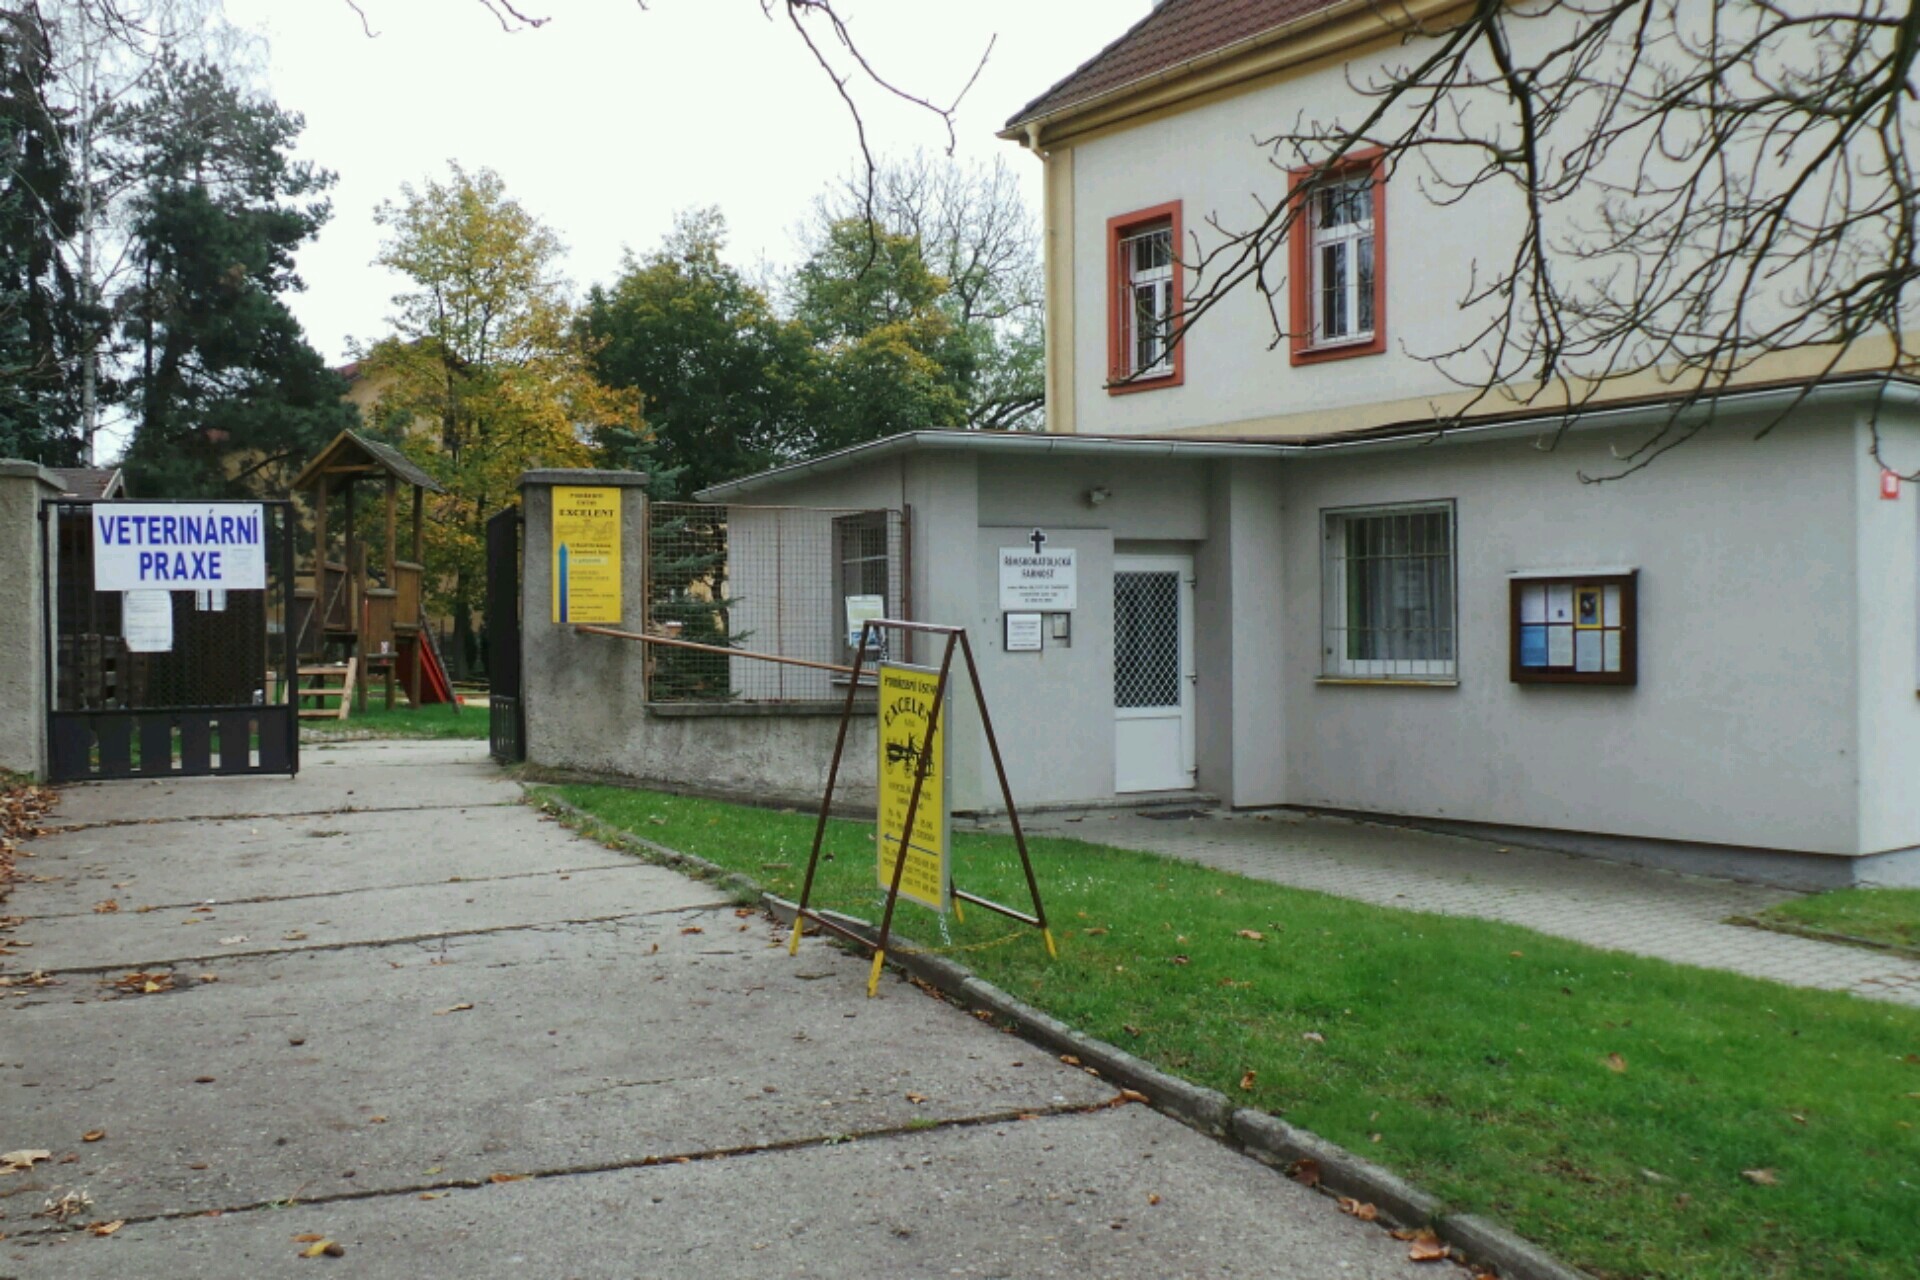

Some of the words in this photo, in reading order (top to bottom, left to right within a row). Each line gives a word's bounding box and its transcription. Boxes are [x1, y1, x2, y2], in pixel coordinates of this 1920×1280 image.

[98, 509, 259, 546] VETERINÁRNÍ
[559, 508, 615, 518] EXCELENT
[139, 551, 222, 581] PRAXE
